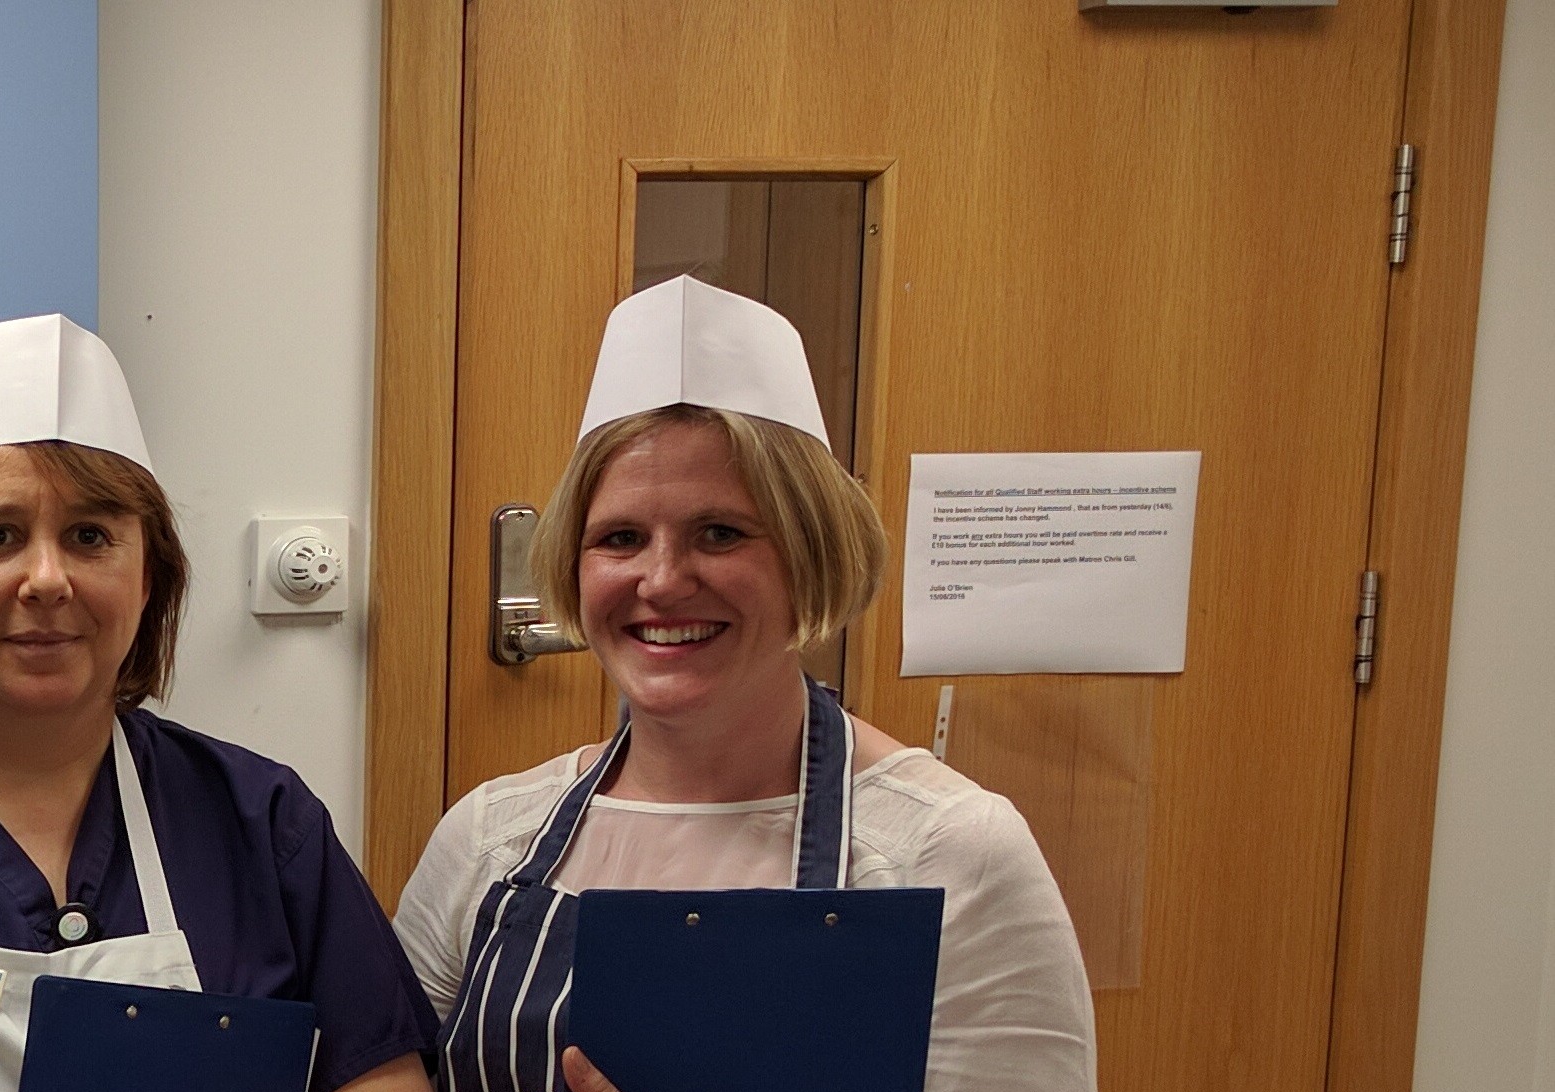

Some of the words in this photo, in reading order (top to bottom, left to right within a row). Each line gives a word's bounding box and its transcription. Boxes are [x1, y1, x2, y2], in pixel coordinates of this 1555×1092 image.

[935, 489, 973, 497] Notification
[995, 488, 1025, 496] Qualified
[1027, 488, 1042, 496] Staff
[1044, 487, 1071, 495] working
[1073, 487, 1089, 495] extra
[1092, 487, 1111, 495] hours
[1119, 486, 1149, 494] incentive
[1151, 486, 1176, 494] scheme
[1119, 504, 1151, 512] yesterday
[1025, 533, 1037, 541] you
[984, 558, 1016, 566] questions
